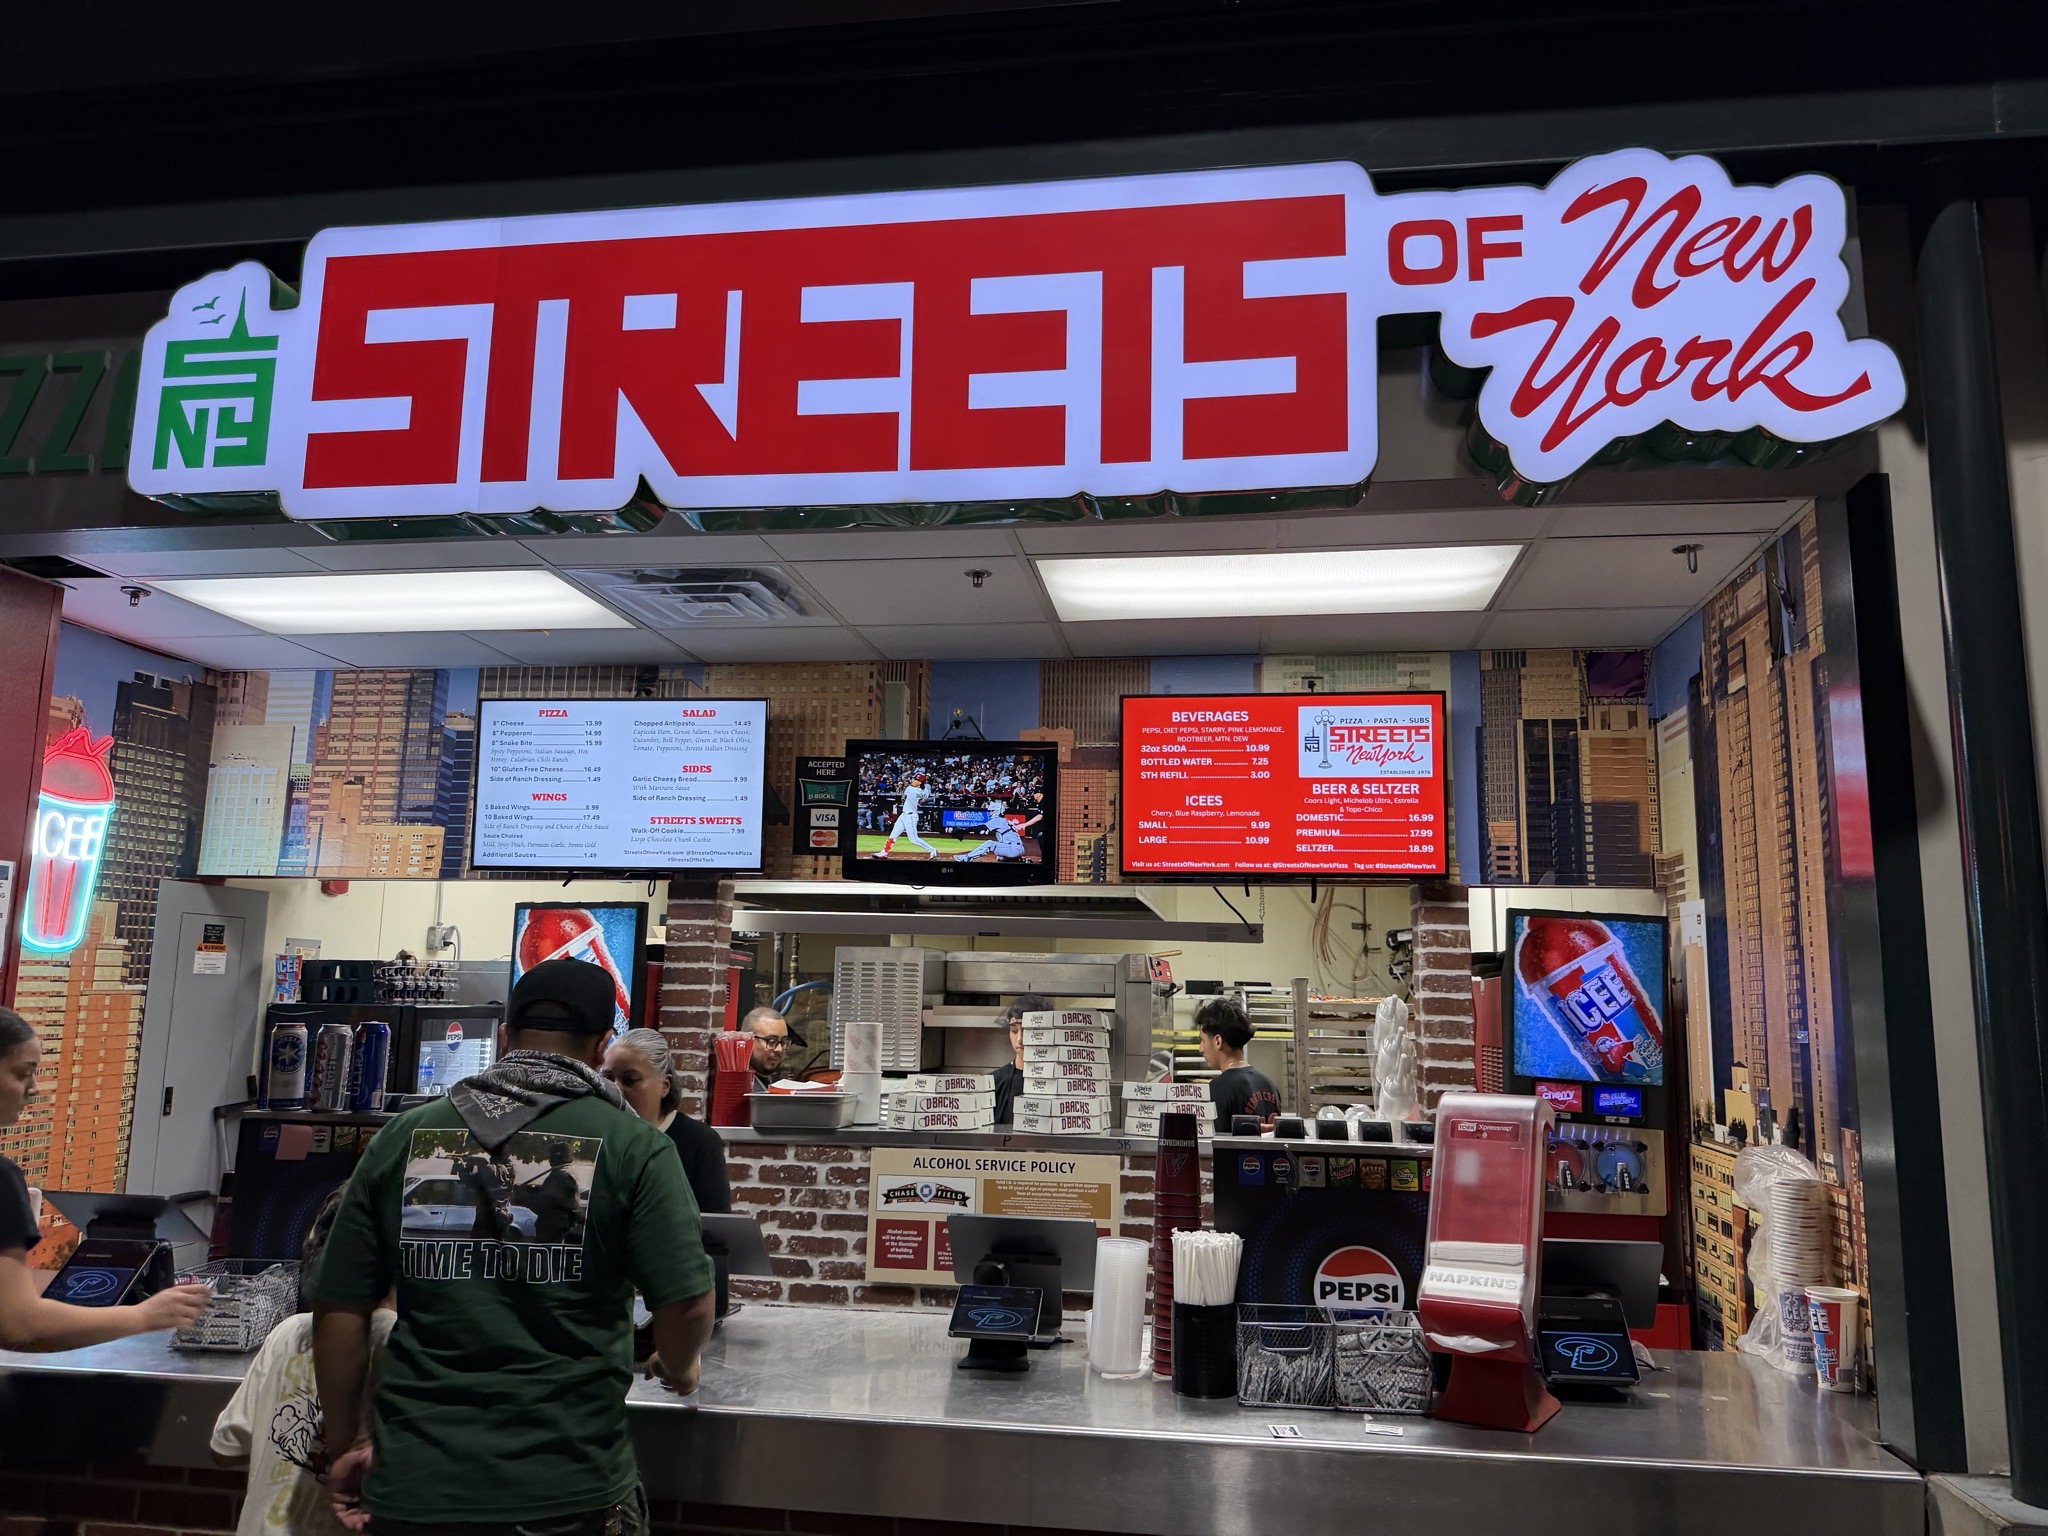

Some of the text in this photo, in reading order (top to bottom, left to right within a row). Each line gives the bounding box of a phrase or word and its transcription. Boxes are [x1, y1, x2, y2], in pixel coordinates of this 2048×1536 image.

[1560, 176, 1813, 310] New
[302, 194, 1348, 489] STREETS
[1388, 215, 1523, 287] OF
[1471, 277, 1873, 453] York
[538, 709, 568, 718] PIZZA
[682, 709, 716, 718] SALAD
[1171, 710, 1249, 723] BEVERAGES
[634, 720, 664, 728] Chopped
[664, 720, 696, 728] Antipasto
[500, 730, 532, 738] Pepperoni
[1142, 727, 1163, 735] PEPSI,
[1179, 727, 1200, 735] PEPSI,
[1201, 727, 1227, 735] STARRY,
[1228, 726, 1244, 734] PINK
[1245, 726, 1285, 734] LEMONADE,
[1330, 725, 1431, 743] STREETS
[1177, 735, 1249, 744] ROOTBEER, MTN. DEW
[1140, 744, 1270, 753] 32oz SODA 10.99
[1330, 744, 1375, 765] OF New
[1371, 742, 1424, 768] York
[808, 761, 845, 769] ACCEPTED
[1140, 757, 1269, 766] BOTTLED WATER 7.25
[682, 765, 712, 774] SIDES
[1140, 771, 1270, 779] STH REFILL 3.00
[533, 776, 562, 784] Dressing
[652, 776, 677, 784] Cheesy
[1312, 783, 1420, 795] BEER & SELTZER
[532, 793, 568, 802] WINGS
[1185, 795, 1223, 806] ICEES
[1324, 797, 1343, 805] Light,
[1374, 797, 1393, 805] Ultra,
[511, 804, 531, 812] Wings
[1345, 806, 1383, 814] Topo-Chico
[513, 814, 534, 822] Wings
[814, 814, 836, 822] VISA
[1150, 810, 1174, 818] Cherry,
[1190, 810, 1226, 818] Raspberry,
[1296, 814, 1434, 822] DOMESTIC 16.99
[650, 816, 743, 826] STREETS SWEETS
[1138, 821, 1270, 829] SMALL 9.99
[32, 809, 106, 861] ICEE
[631, 827, 660, 835] Walk-Off
[1296, 829, 1433, 837] PREMIUM 17.99
[1138, 836, 1270, 844] LARGE 10.99
[1296, 844, 1434, 853] SELTZER 18.99
[276, 959, 300, 974] ICEE
[1557, 965, 1636, 1038] ICEE
[446, 1031, 464, 1043] PEPSI
[913, 1157, 1076, 1174] ALCOHOL SERVICE POLICY
[889, 1189, 963, 1200] CHASE FIELD
[399, 1241, 583, 1284] TIME TO DIE
[1429, 1271, 1519, 1291] NAPKINS
[1319, 1281, 1399, 1304] PEPSI
[1783, 1306, 1808, 1321] ICEE
